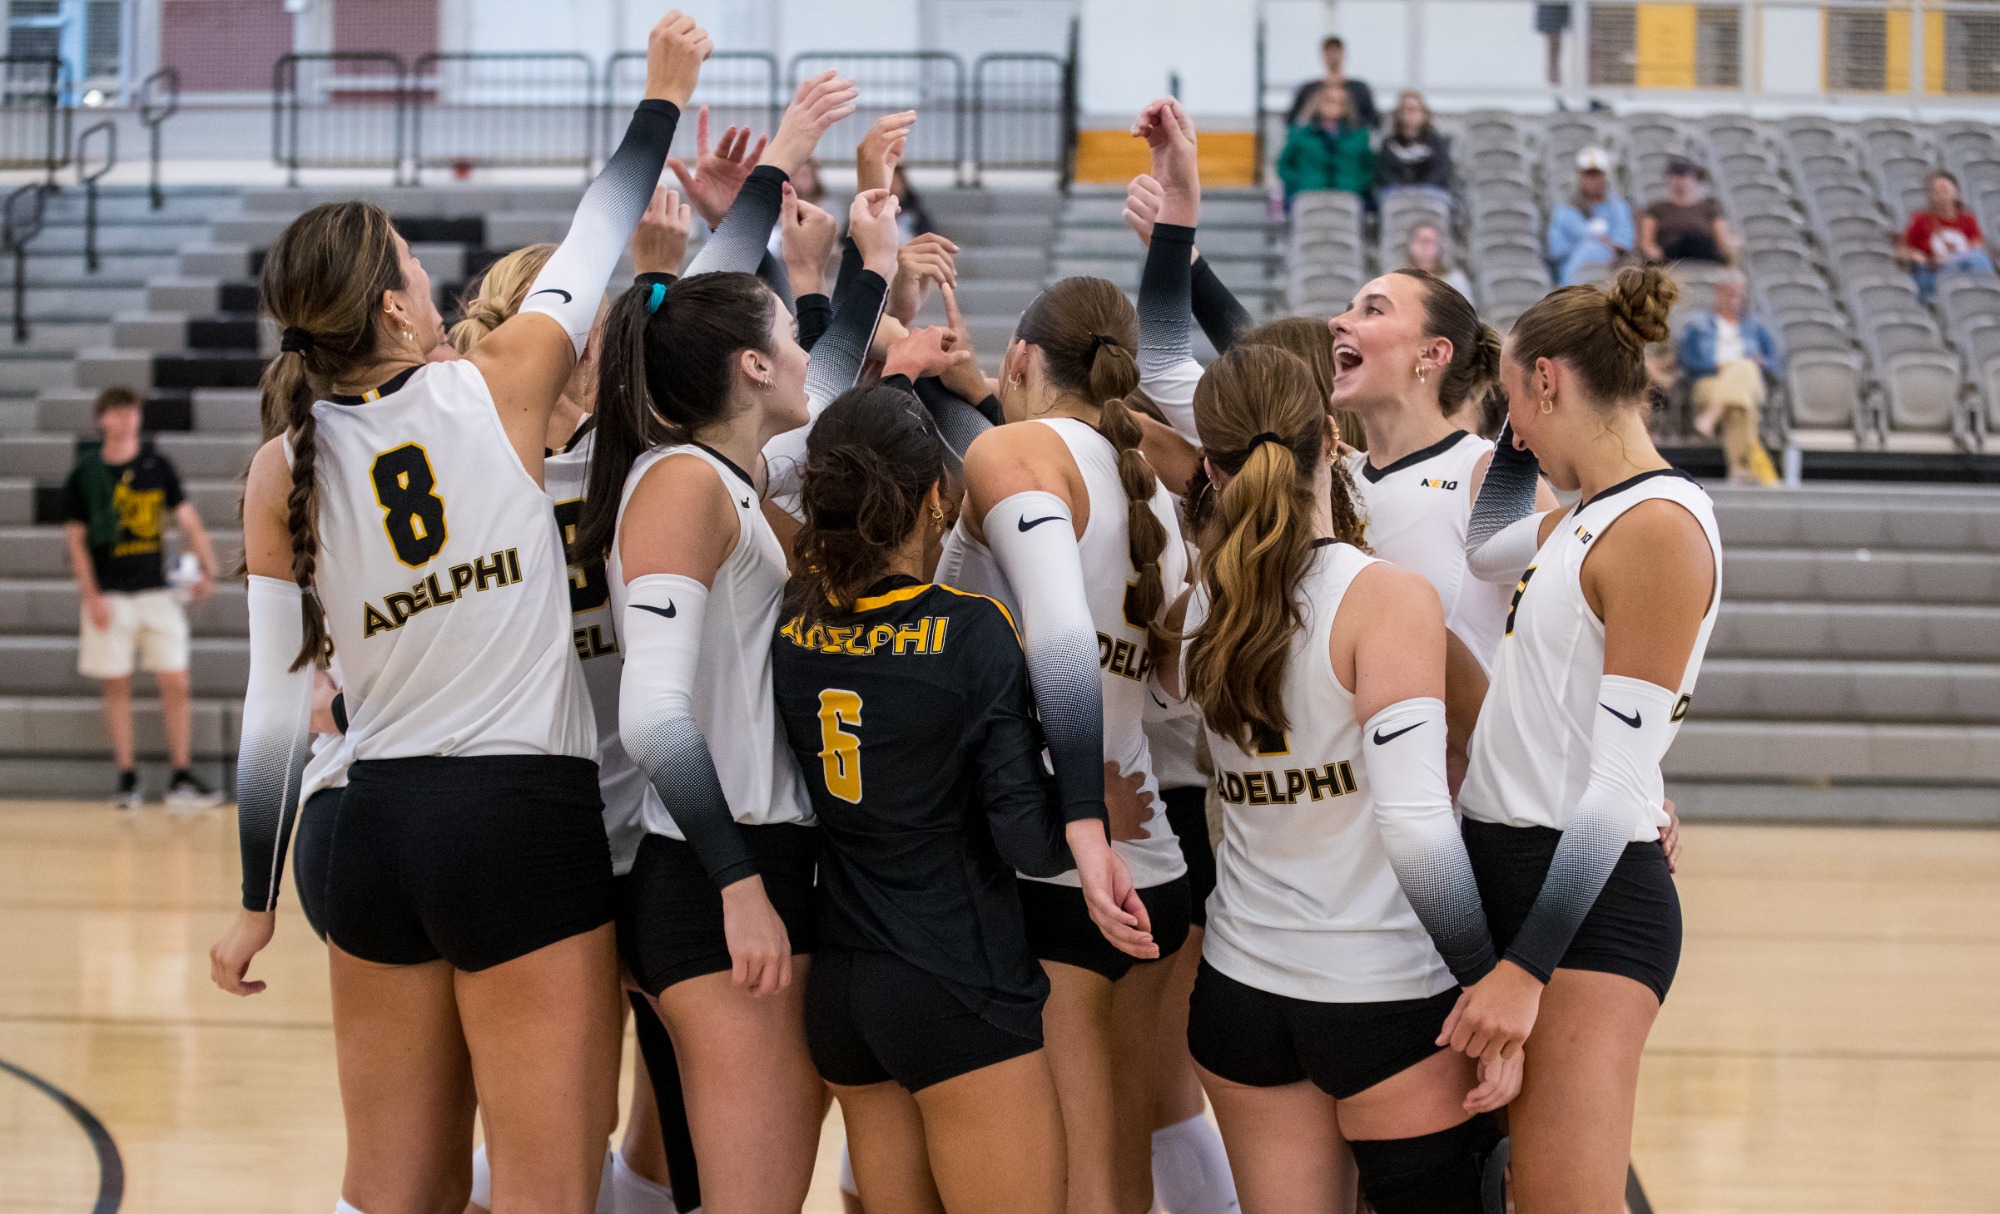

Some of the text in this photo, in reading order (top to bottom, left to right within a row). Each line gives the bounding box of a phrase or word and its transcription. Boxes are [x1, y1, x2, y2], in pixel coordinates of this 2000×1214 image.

[369, 441, 449, 570] 8
[363, 547, 523, 639] ADELPHI
[780, 613, 949, 655] ADELPHI
[817, 688, 863, 804] 6
